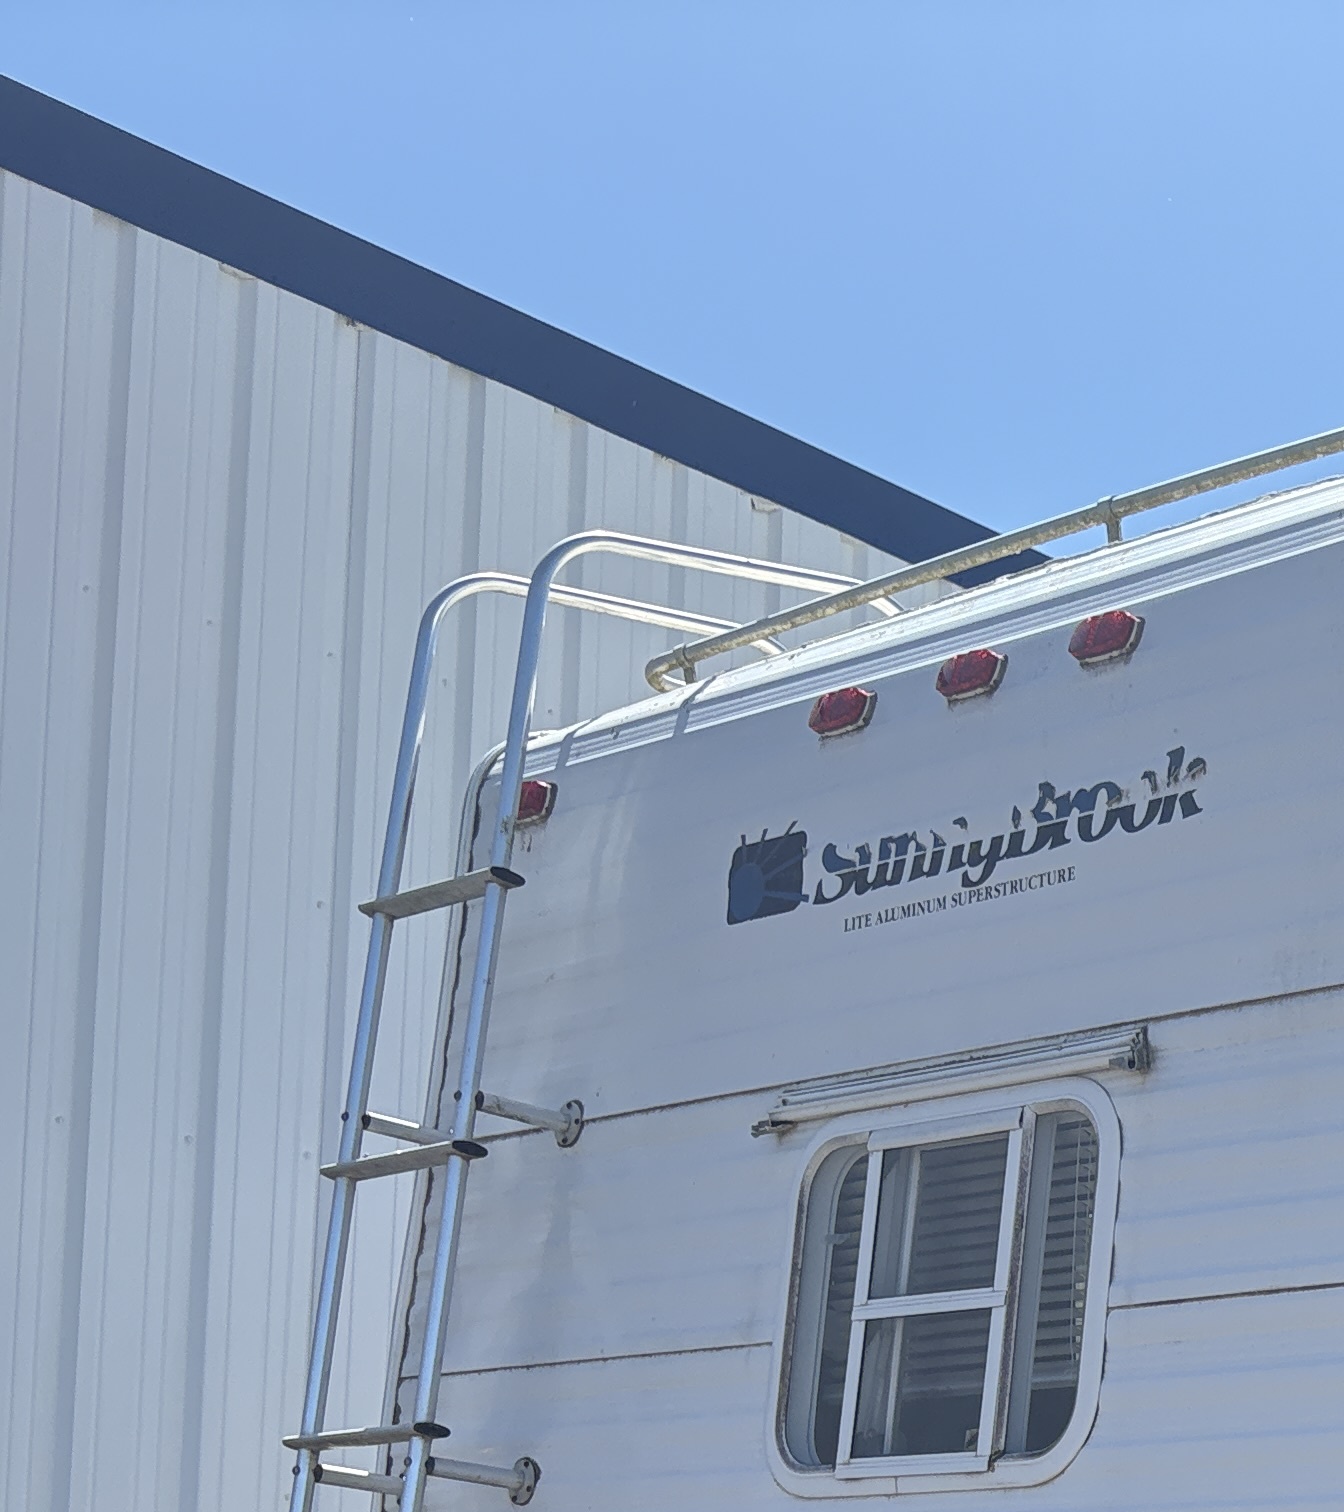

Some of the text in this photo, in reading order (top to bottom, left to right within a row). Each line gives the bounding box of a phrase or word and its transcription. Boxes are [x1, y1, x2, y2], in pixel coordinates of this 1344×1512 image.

[843, 866, 1076, 933] LITE ALUMINUM SUPERSTRUCTURE
